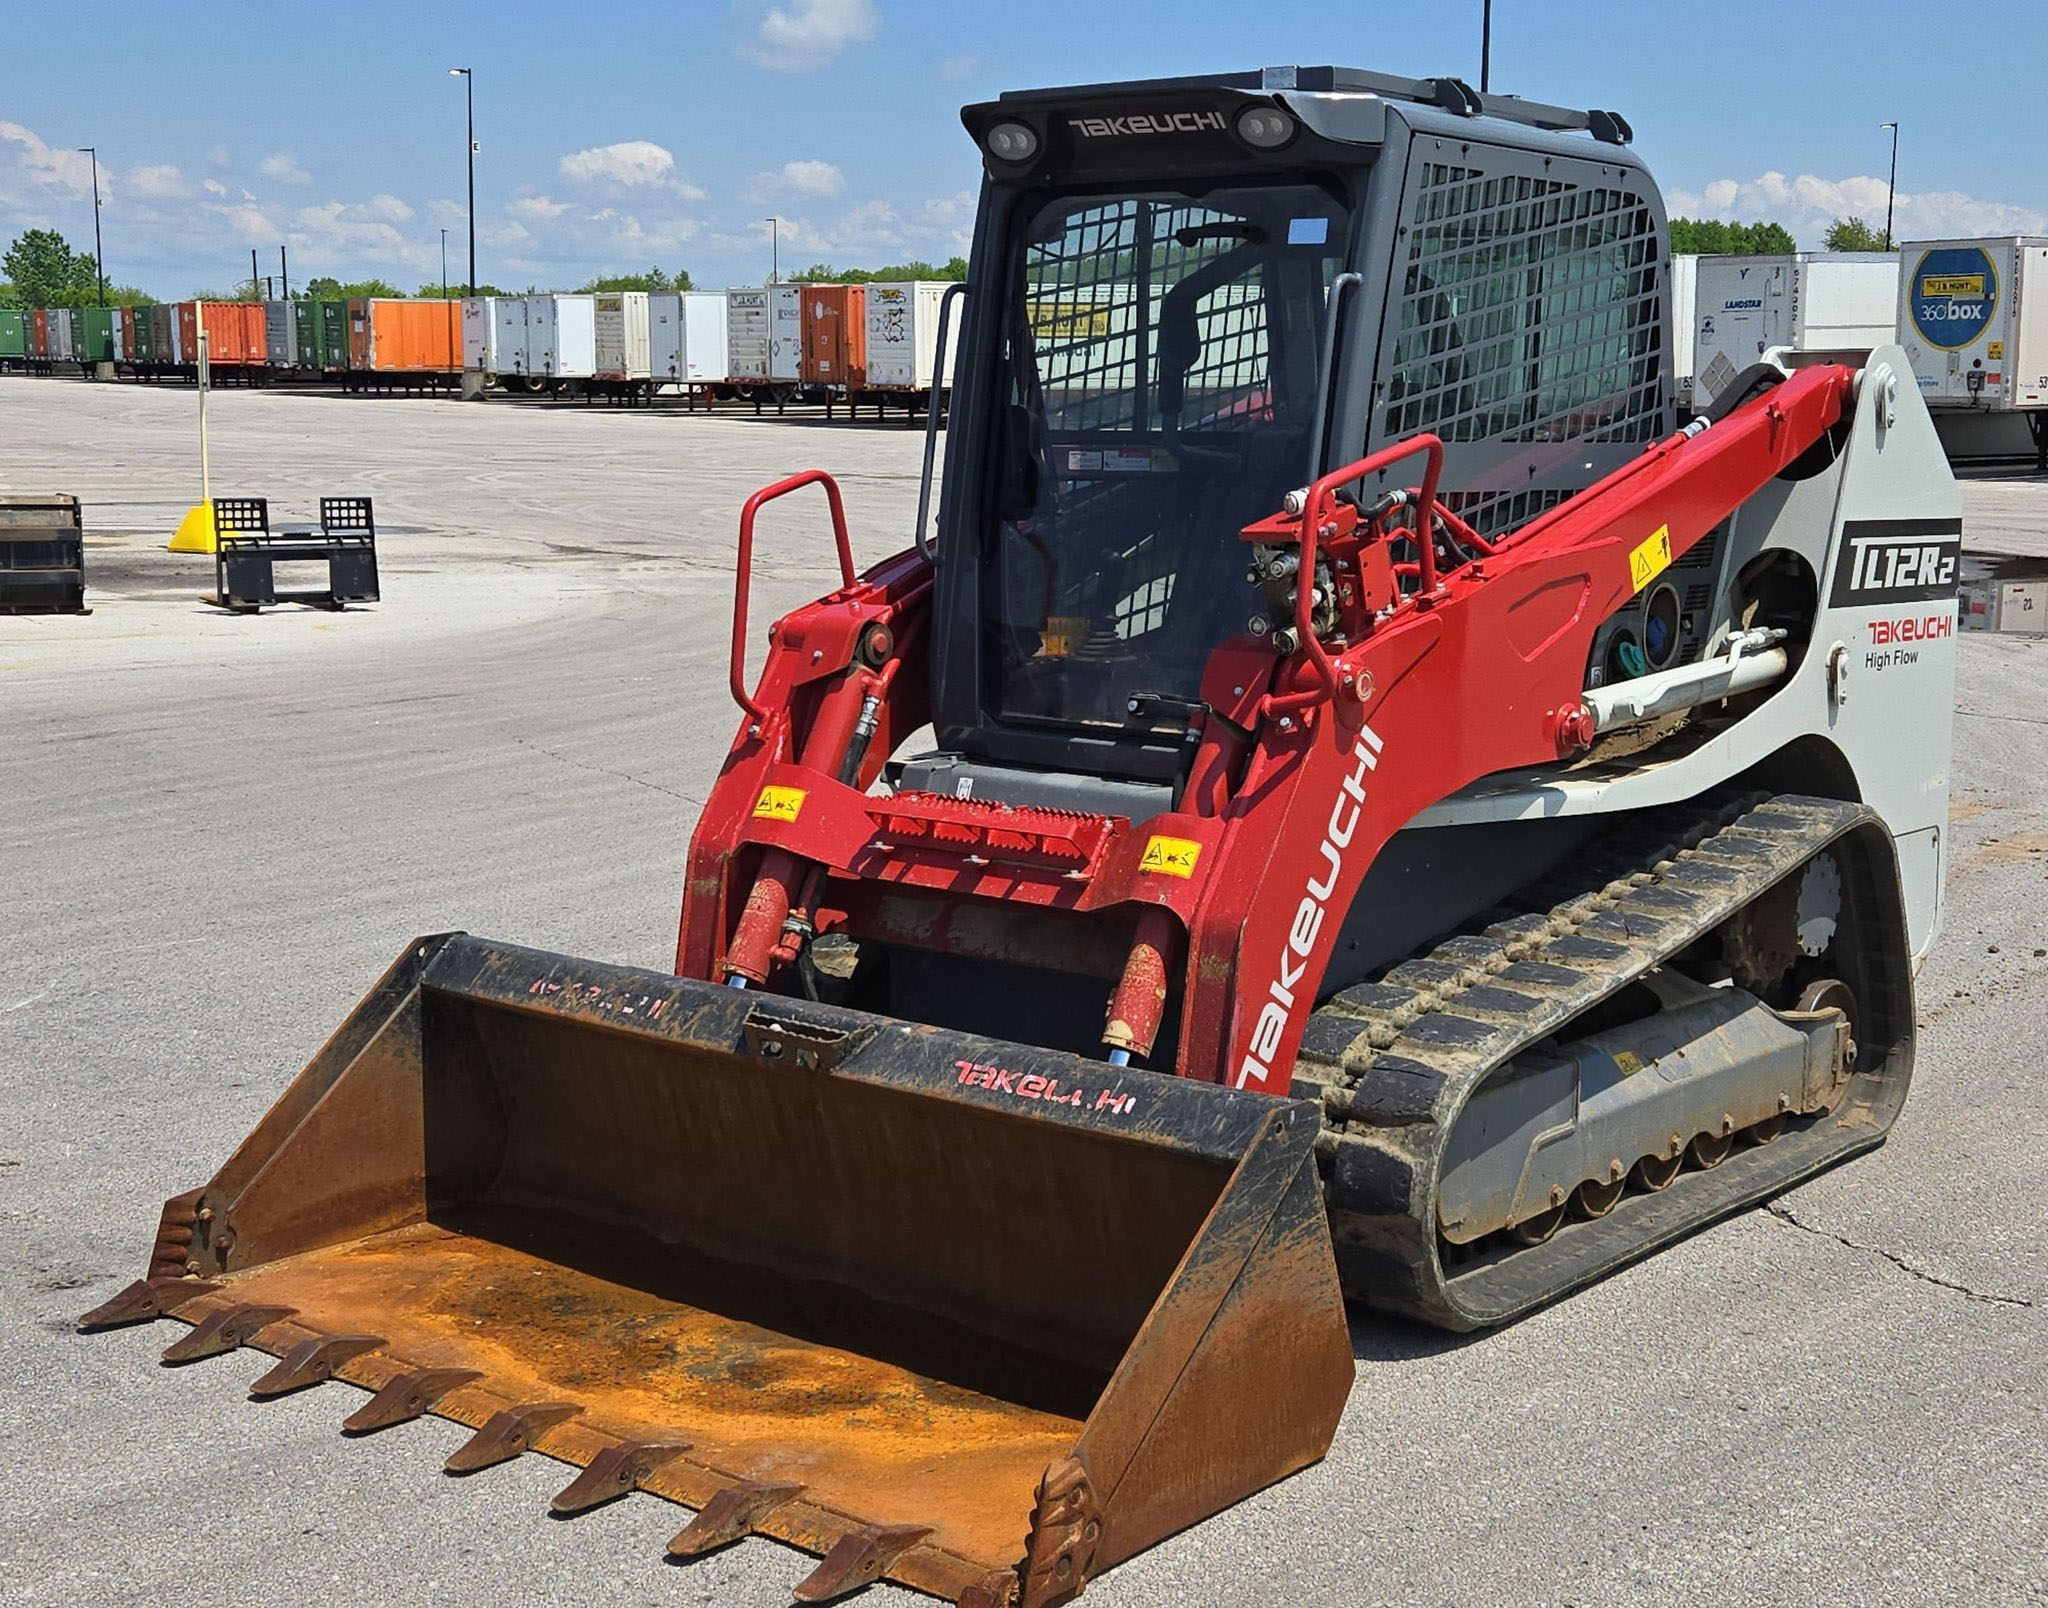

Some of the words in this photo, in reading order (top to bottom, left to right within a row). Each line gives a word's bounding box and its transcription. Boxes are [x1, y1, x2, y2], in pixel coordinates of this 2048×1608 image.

[1725, 300, 1762, 309] LANDSTAR
[1849, 534, 1961, 590] TL12R2
[1865, 650, 1891, 671] High
[1893, 649, 1919, 666] Flow
